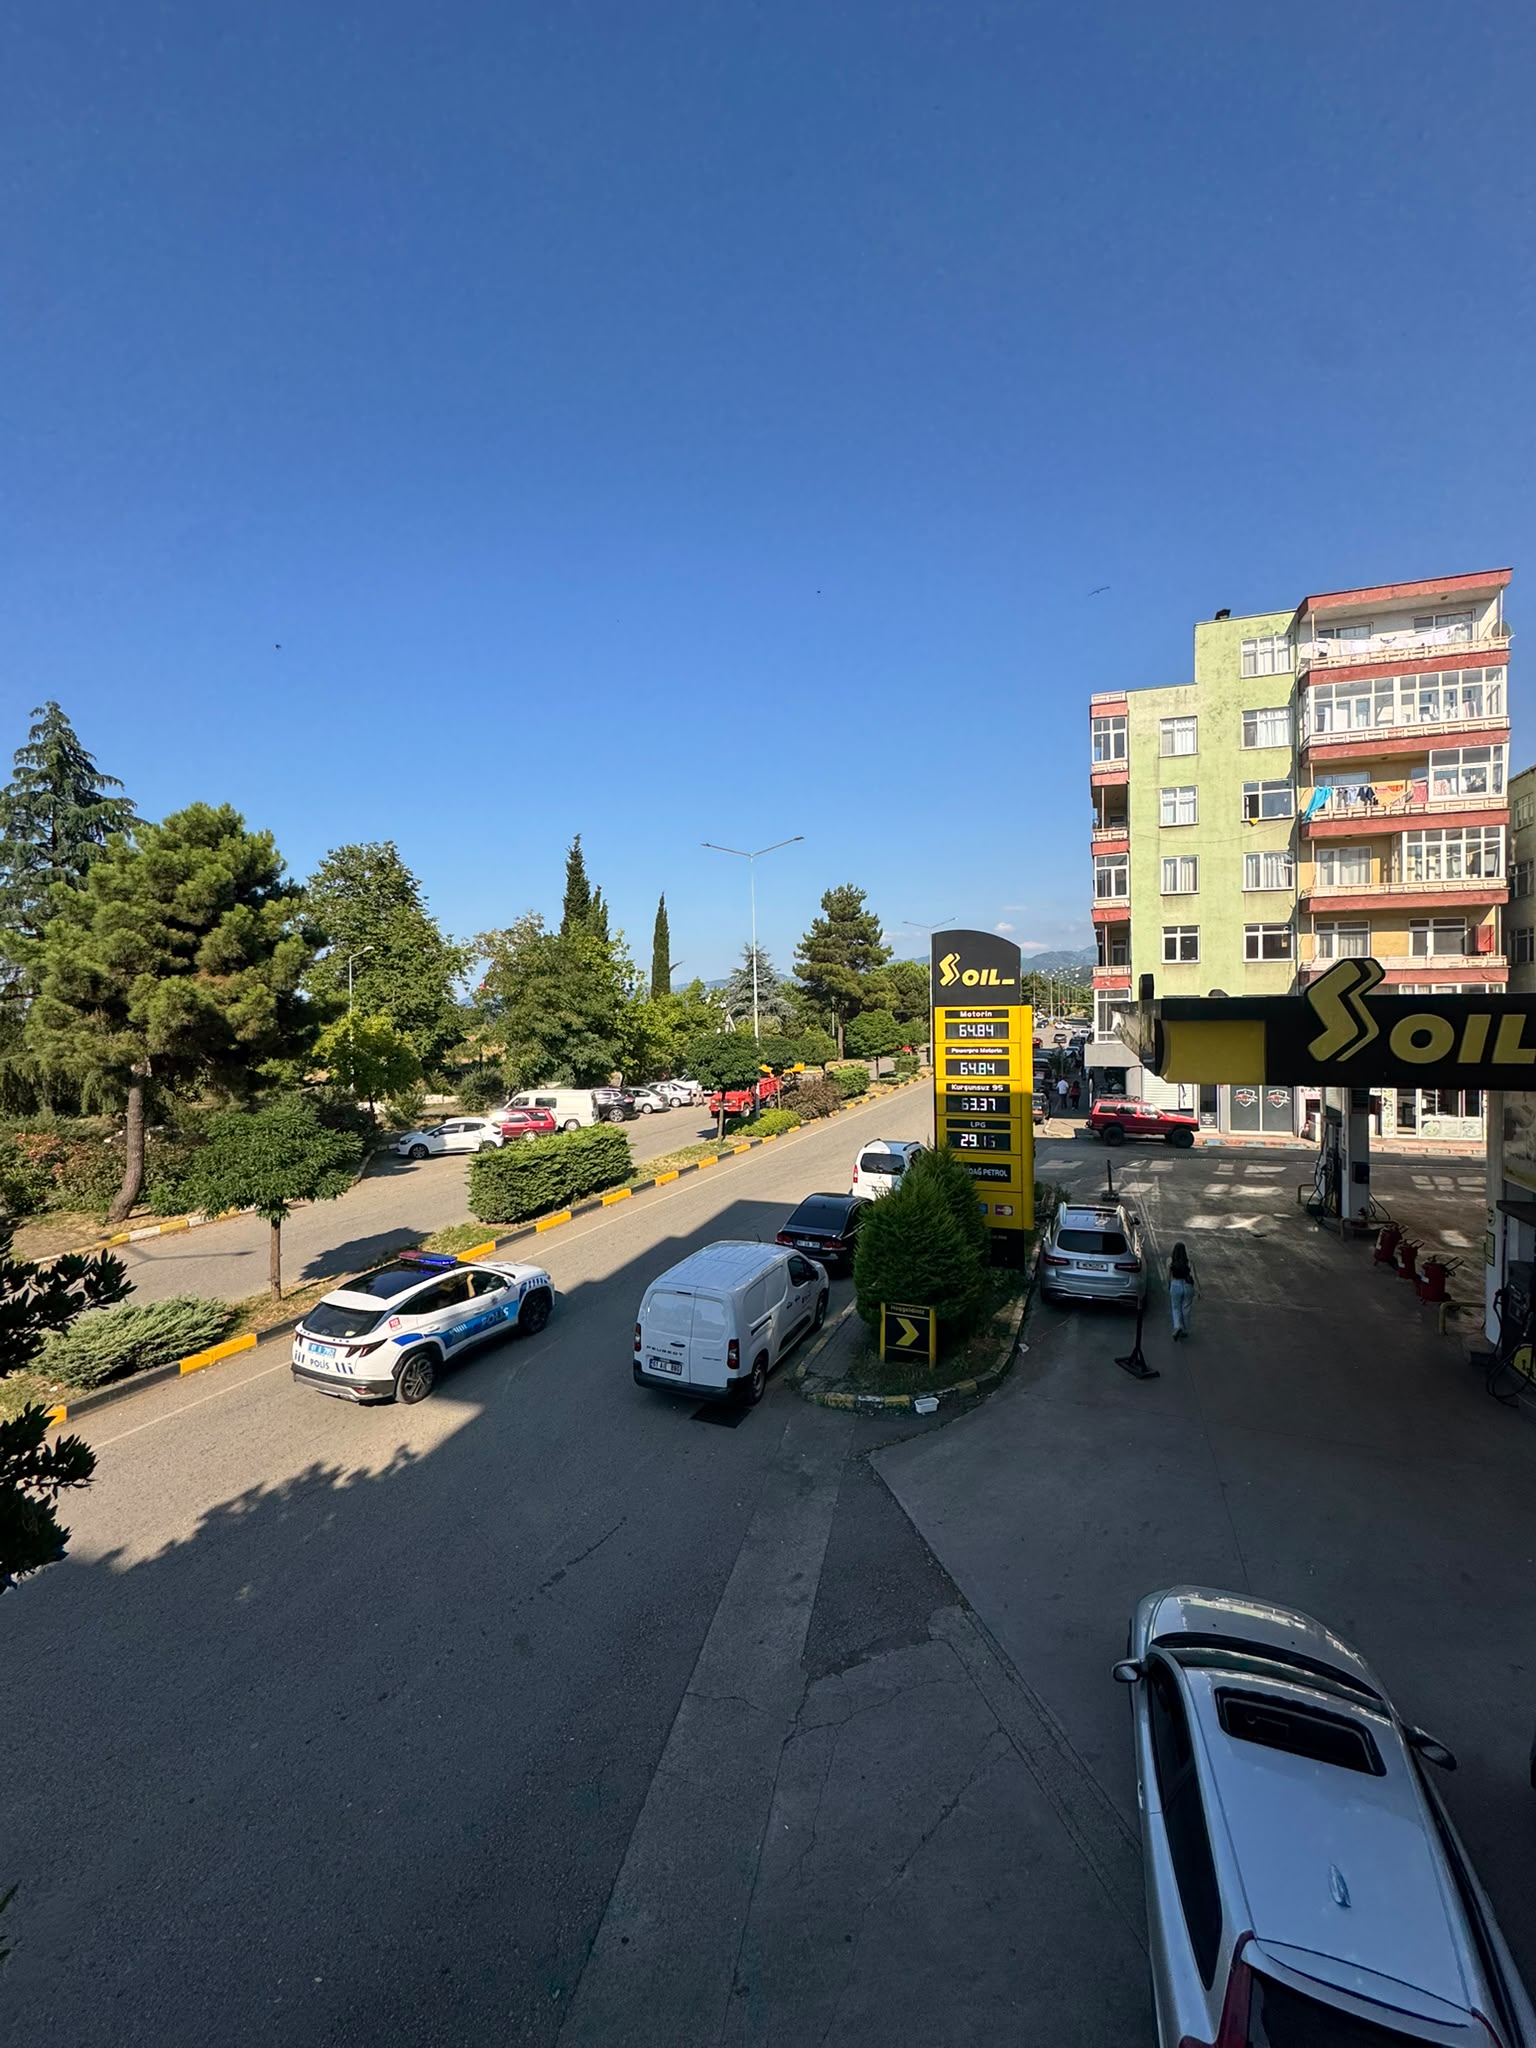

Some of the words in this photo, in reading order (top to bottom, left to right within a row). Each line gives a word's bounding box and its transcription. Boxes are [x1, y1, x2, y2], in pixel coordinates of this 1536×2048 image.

[960, 1010, 993, 1018] Motorin
[959, 1024, 994, 1037] 64.84
[960, 1062, 995, 1075] 64.84
[992, 1084, 1004, 1092] 95
[961, 1097, 996, 1111] 63.37
[983, 1168, 1008, 1178] PETROL
